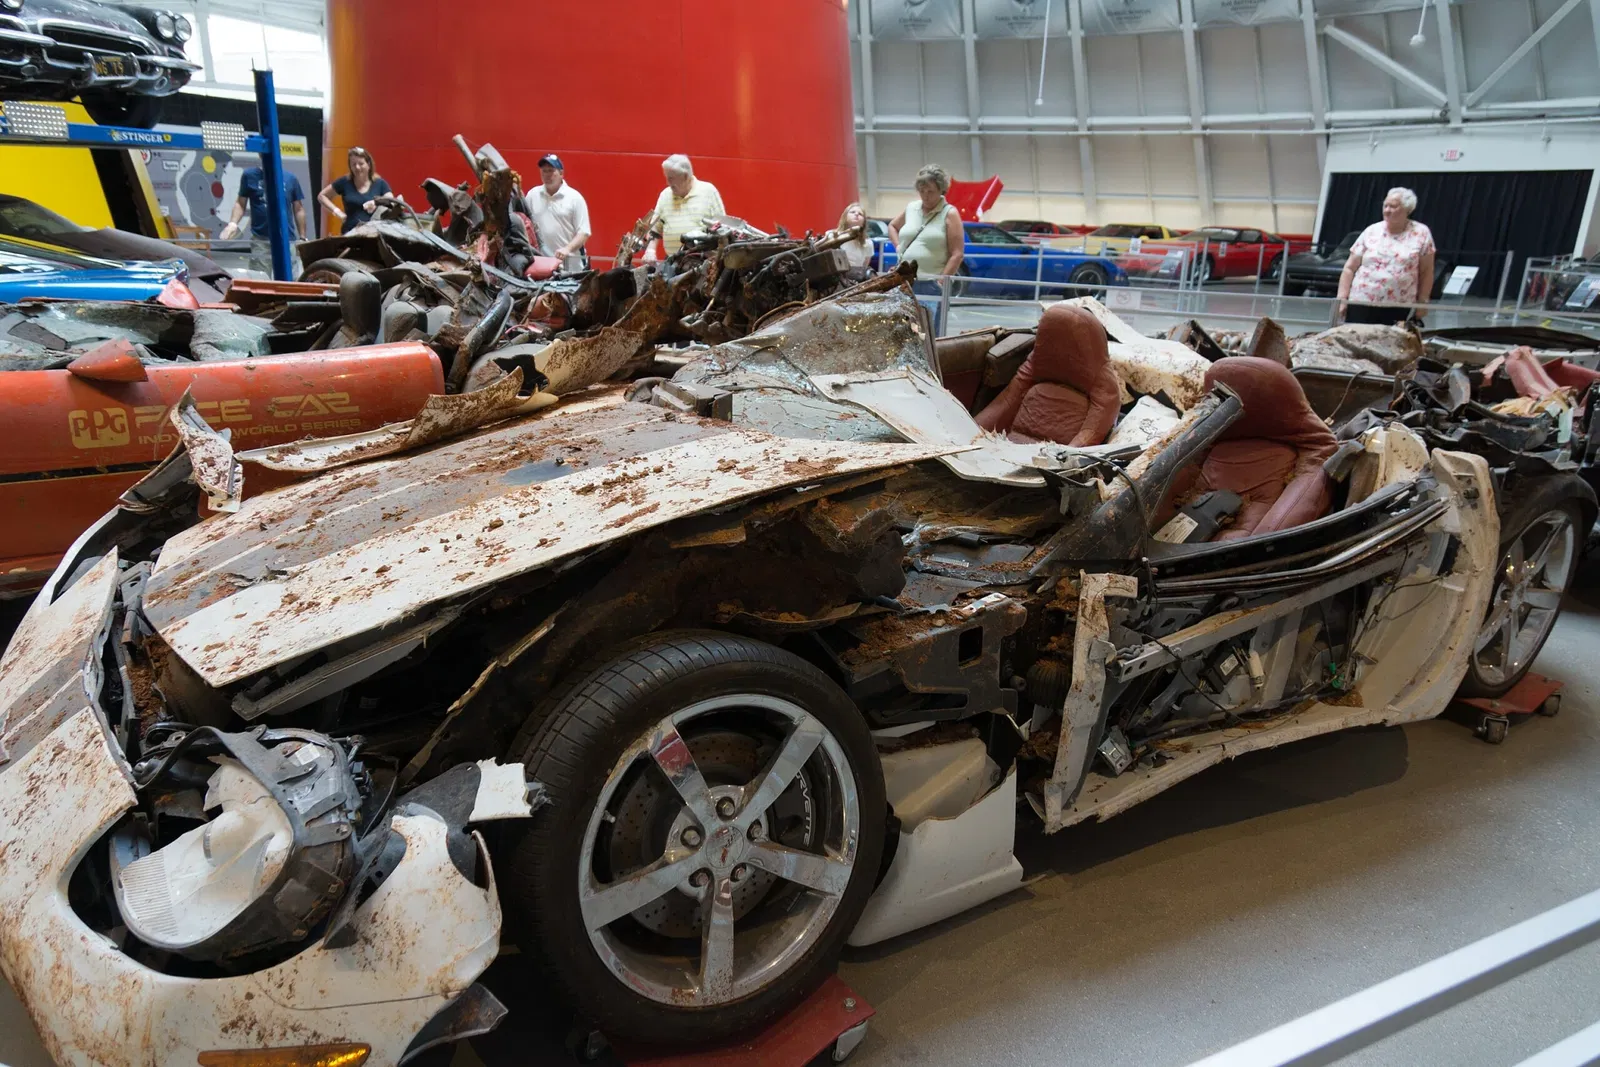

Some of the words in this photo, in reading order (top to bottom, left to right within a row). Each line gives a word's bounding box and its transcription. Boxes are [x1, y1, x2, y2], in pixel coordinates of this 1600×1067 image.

[122, 131, 164, 143] STINGER
[71, 407, 128, 441] PPG
[133, 399, 253, 428] PCE
[232, 424, 298, 438] WORLD
[301, 418, 361, 431] SERIES
[795, 769, 812, 847] RVETTE
